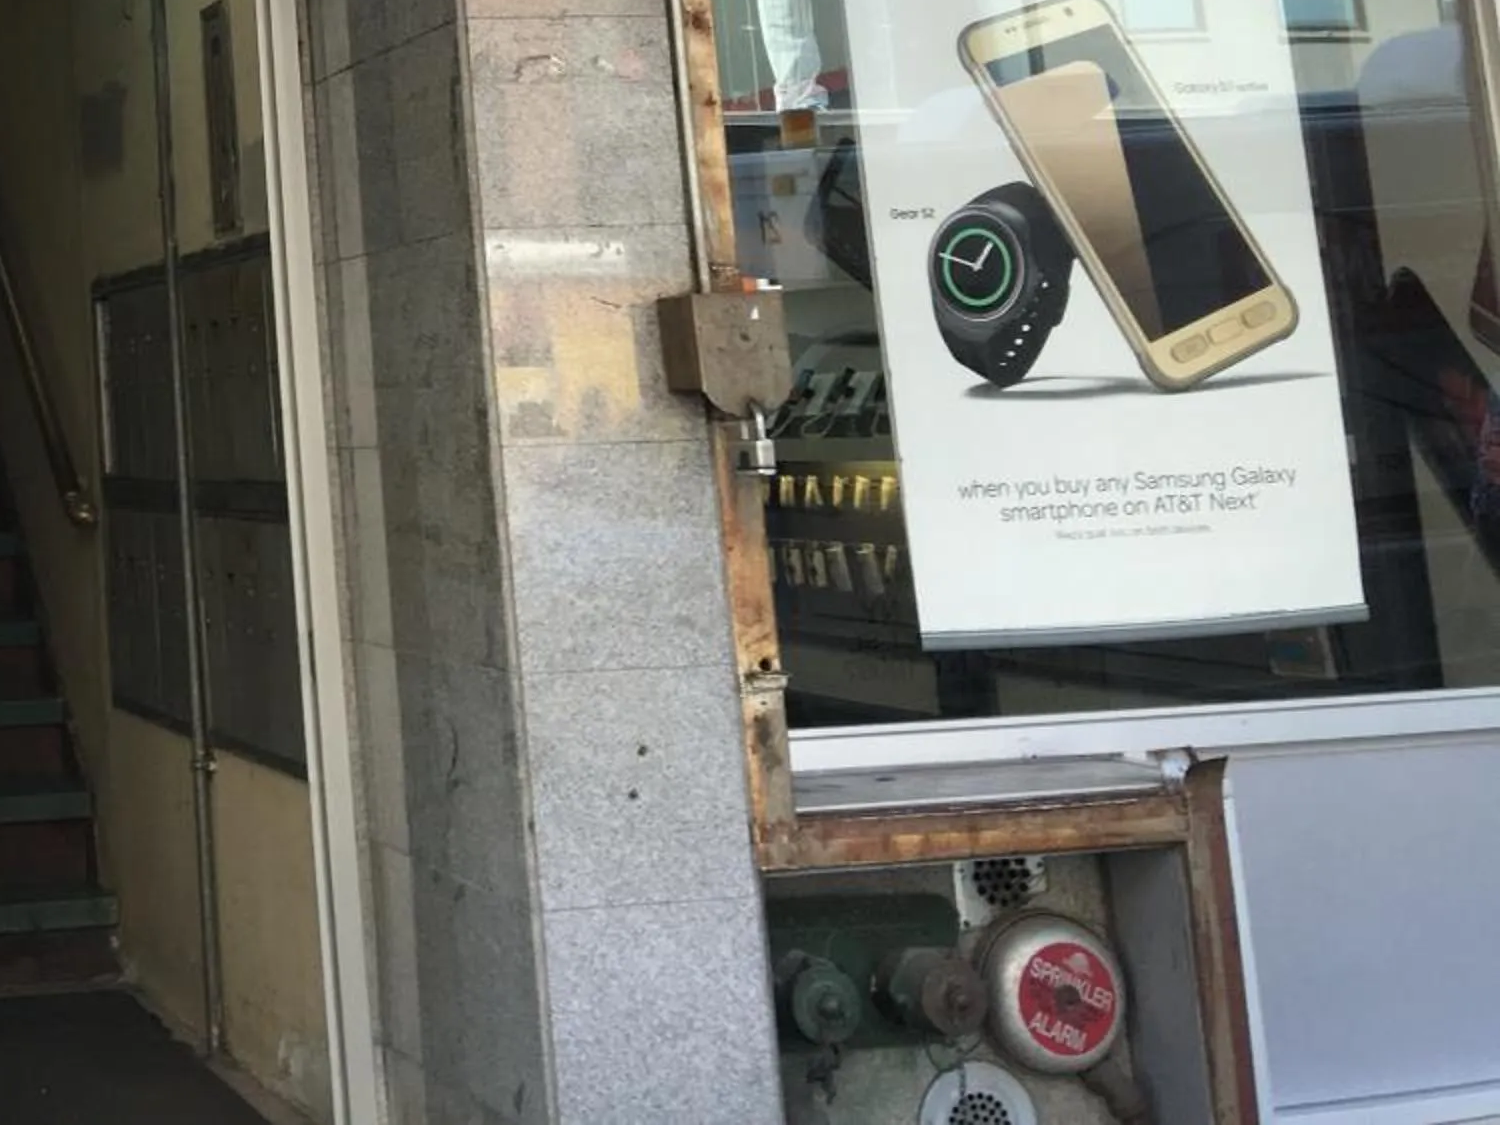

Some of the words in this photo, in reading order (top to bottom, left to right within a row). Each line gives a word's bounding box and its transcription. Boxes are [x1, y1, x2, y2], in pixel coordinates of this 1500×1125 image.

[958, 477, 1010, 500] when
[1015, 479, 1052, 500] you
[1054, 474, 1092, 498] buy
[1095, 476, 1131, 495] any
[1134, 471, 1227, 491] Samsung
[1231, 466, 1297, 487] Galaxy
[999, 497, 1119, 523] smartphone
[1123, 500, 1150, 517] on
[1154, 494, 1203, 514] AT&T
[1028, 1011, 1088, 1052] ALARM
